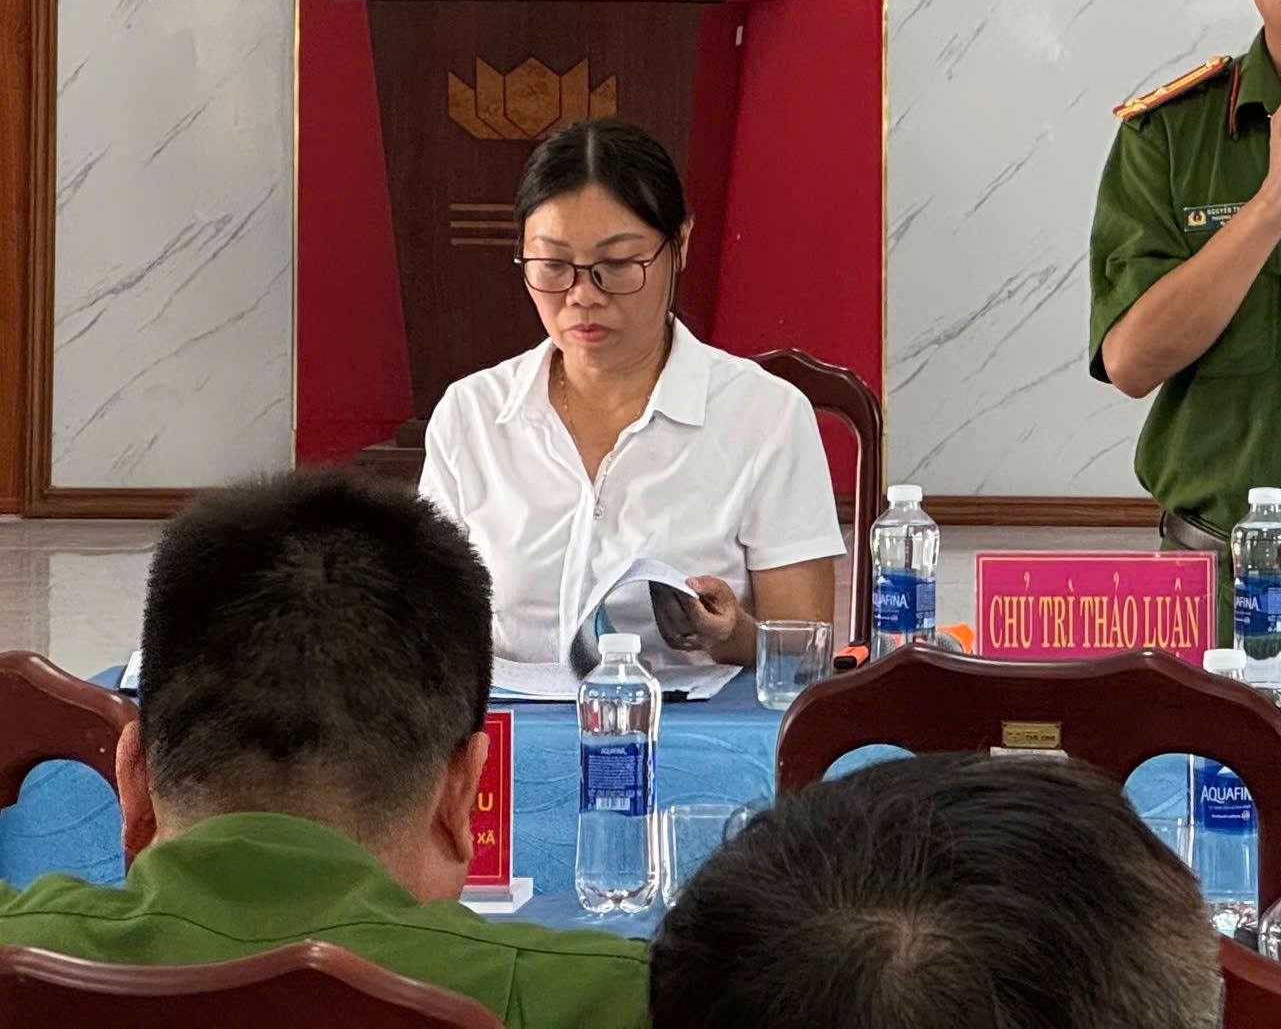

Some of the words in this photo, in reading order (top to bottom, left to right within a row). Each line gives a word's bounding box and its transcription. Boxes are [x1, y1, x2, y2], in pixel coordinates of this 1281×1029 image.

[989, 572, 1034, 649] CHỦ
[1039, 579, 1075, 648] TRÌ
[1080, 572, 1138, 649] THẢO
[1143, 578, 1199, 658] LUẬN
[1200, 785, 1252, 804] AQUAFIN
[477, 829, 496, 845] XÃ
